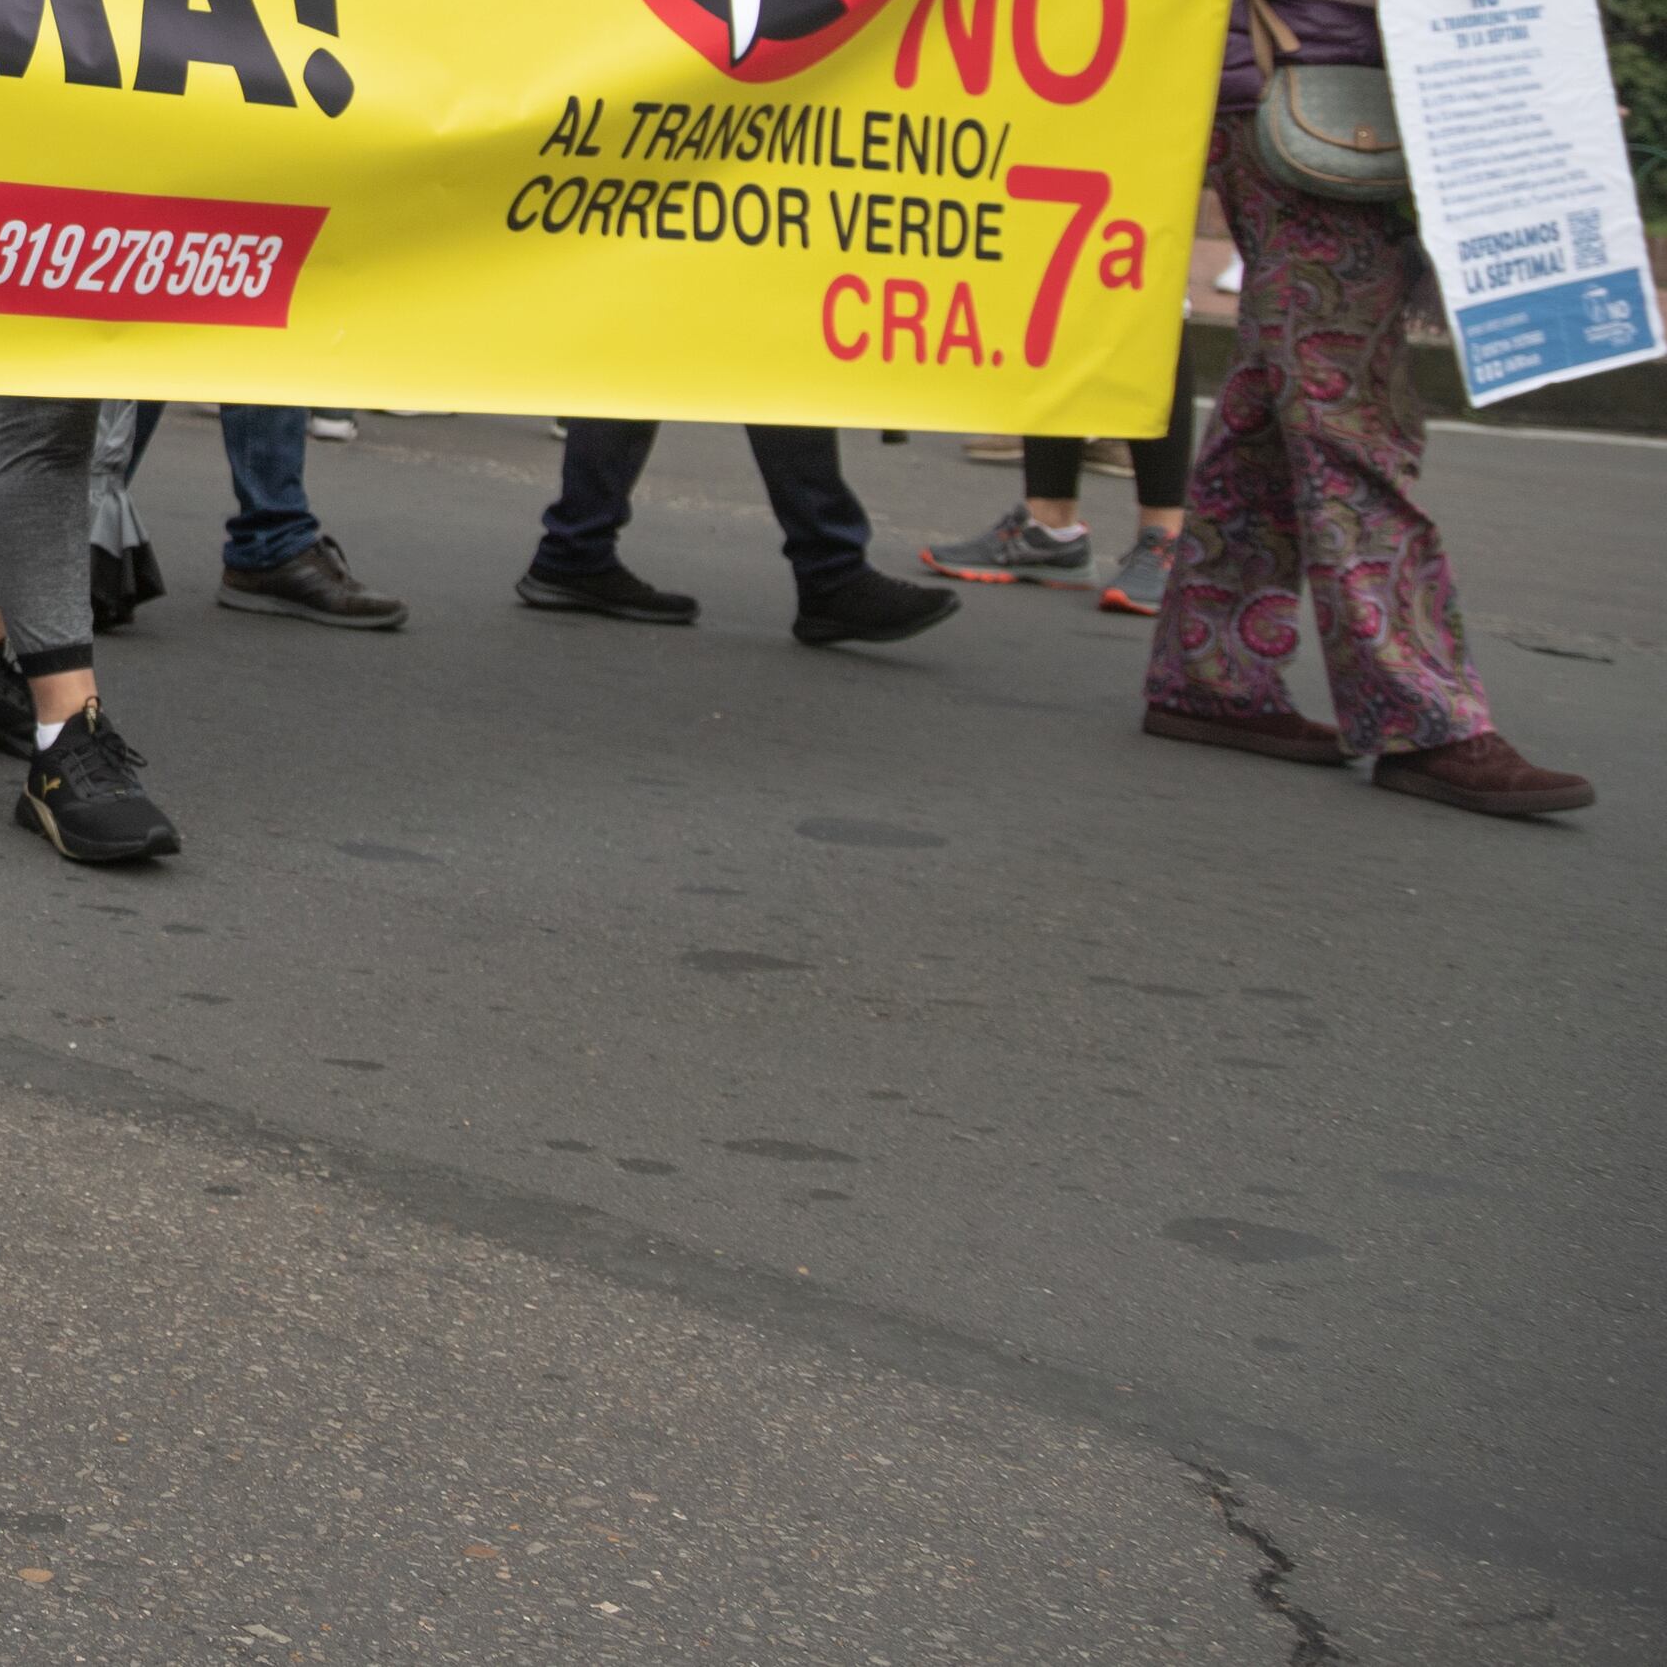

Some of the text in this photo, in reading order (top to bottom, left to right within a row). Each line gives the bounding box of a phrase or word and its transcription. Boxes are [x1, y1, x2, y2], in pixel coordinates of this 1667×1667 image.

[540, 96, 1012, 181] AL TRANSMILENIO/
[507, 175, 1005, 262] CORREDOR VERDE
[822, 272, 1005, 369] CRA.
